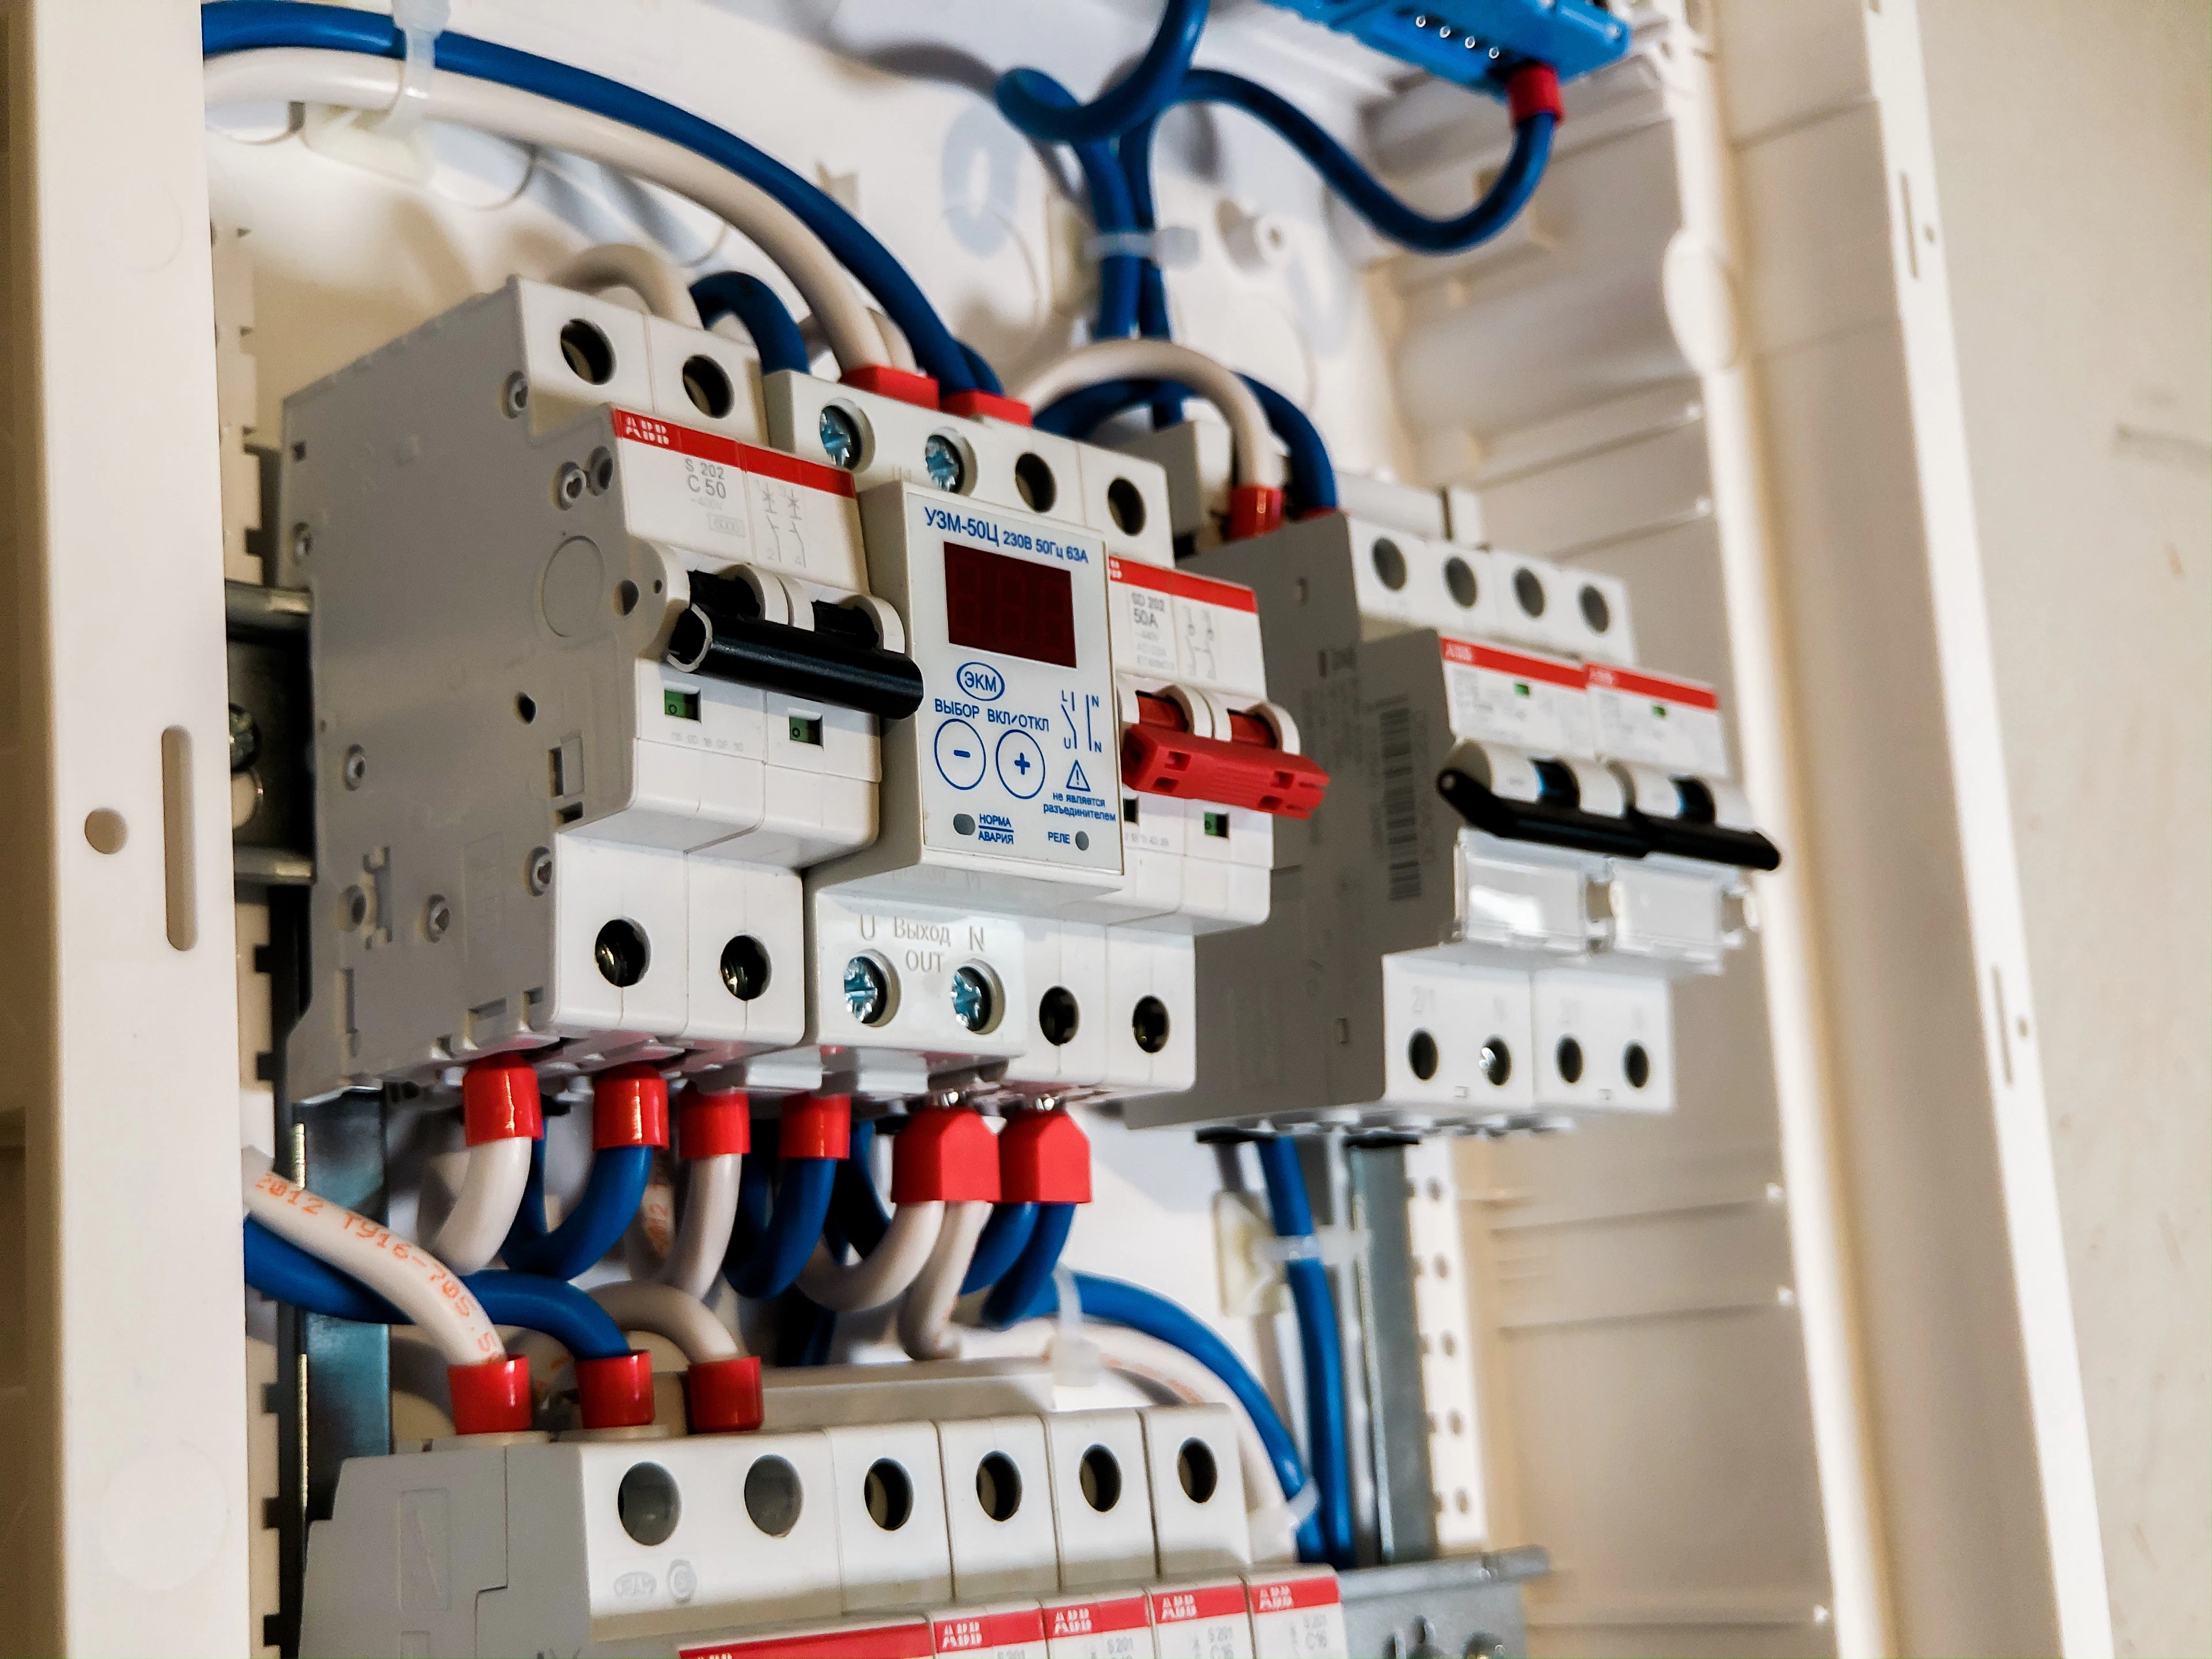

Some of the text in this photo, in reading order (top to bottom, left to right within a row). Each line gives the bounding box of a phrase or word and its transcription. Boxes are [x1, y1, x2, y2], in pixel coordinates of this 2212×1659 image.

[626, 416, 669, 445] ABB
[684, 458, 725, 480] S 202
[924, 506, 1089, 564] УЗМ-50Ц 230В 50Гц 63А
[1134, 608, 1159, 628] 50A
[964, 671, 997, 692] ЭКМ
[934, 698, 1050, 733] ВЫБОР ВКЛ/ОТКЛ
[1043, 803, 1116, 822] разъединителем
[1052, 792, 1105, 808] не является
[979, 813, 1012, 828] НОРМА
[978, 831, 1014, 845] АВАРИЯ
[1047, 831, 1071, 844] РЕЛЕ
[860, 914, 986, 952] U Выход N
[906, 948, 945, 973] OUT
[1161, 1593, 1198, 1620] ABB
[1259, 1585, 1294, 1610] ABB
[1054, 1607, 1093, 1635] ABB
[941, 1620, 983, 1649] ABB
